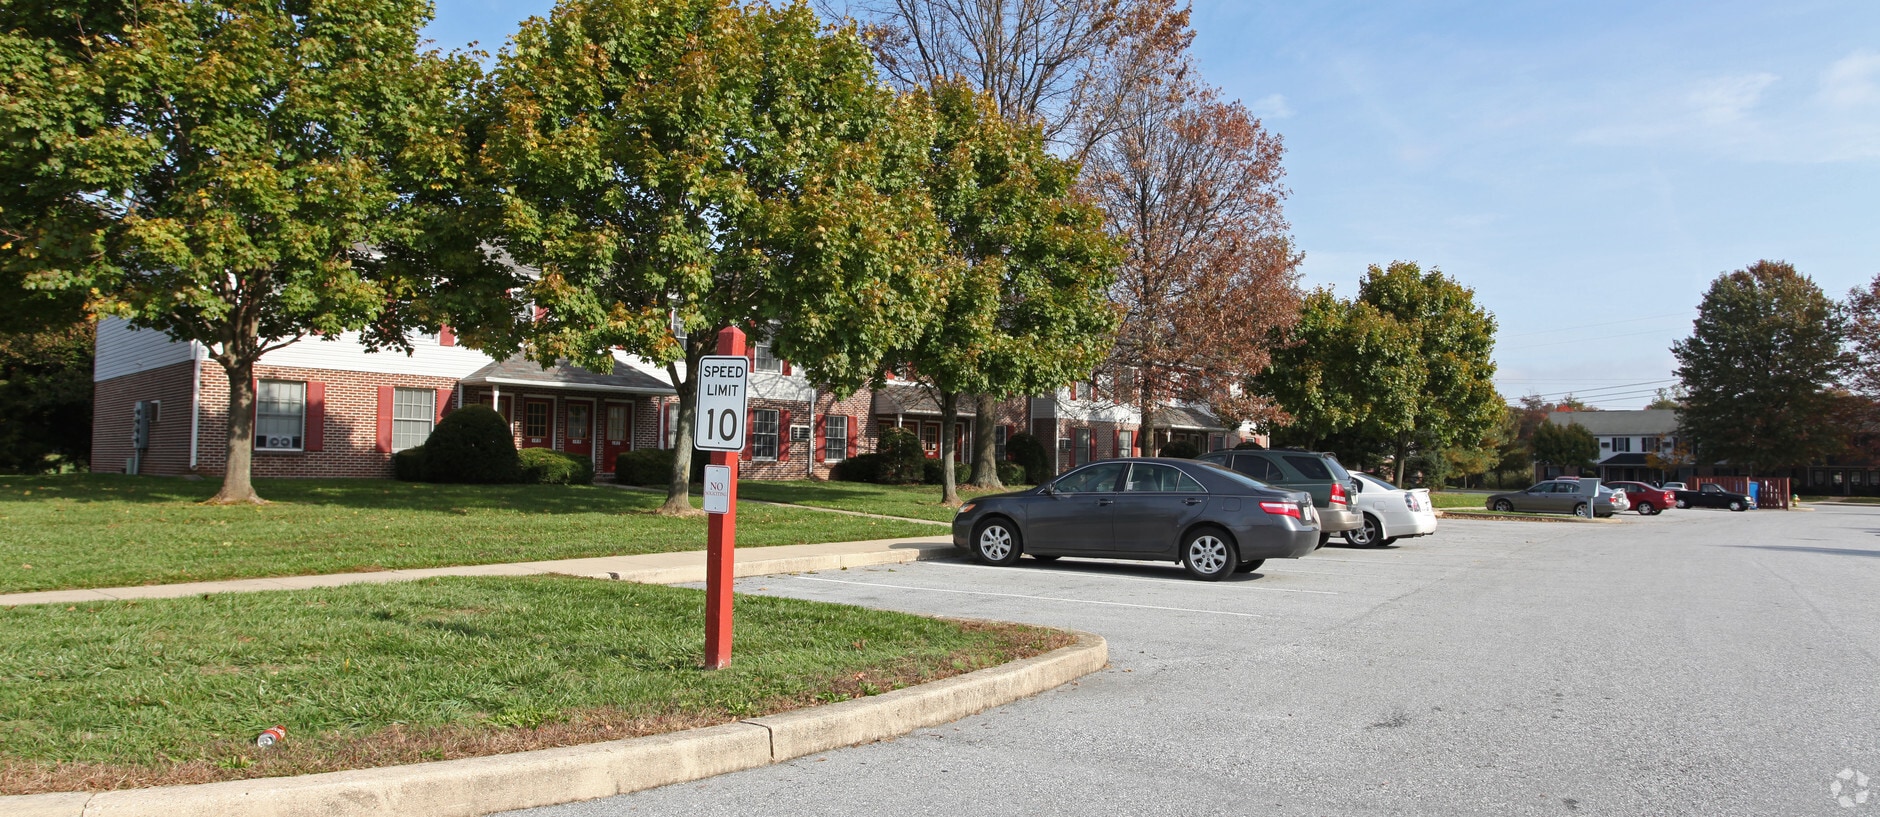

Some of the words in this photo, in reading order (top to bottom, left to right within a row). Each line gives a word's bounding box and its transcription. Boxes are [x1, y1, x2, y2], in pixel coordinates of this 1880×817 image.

[703, 365, 744, 378] SPEED
[707, 384, 739, 397] LIMIT
[707, 408, 737, 441] 10
[710, 481, 724, 491] NO
